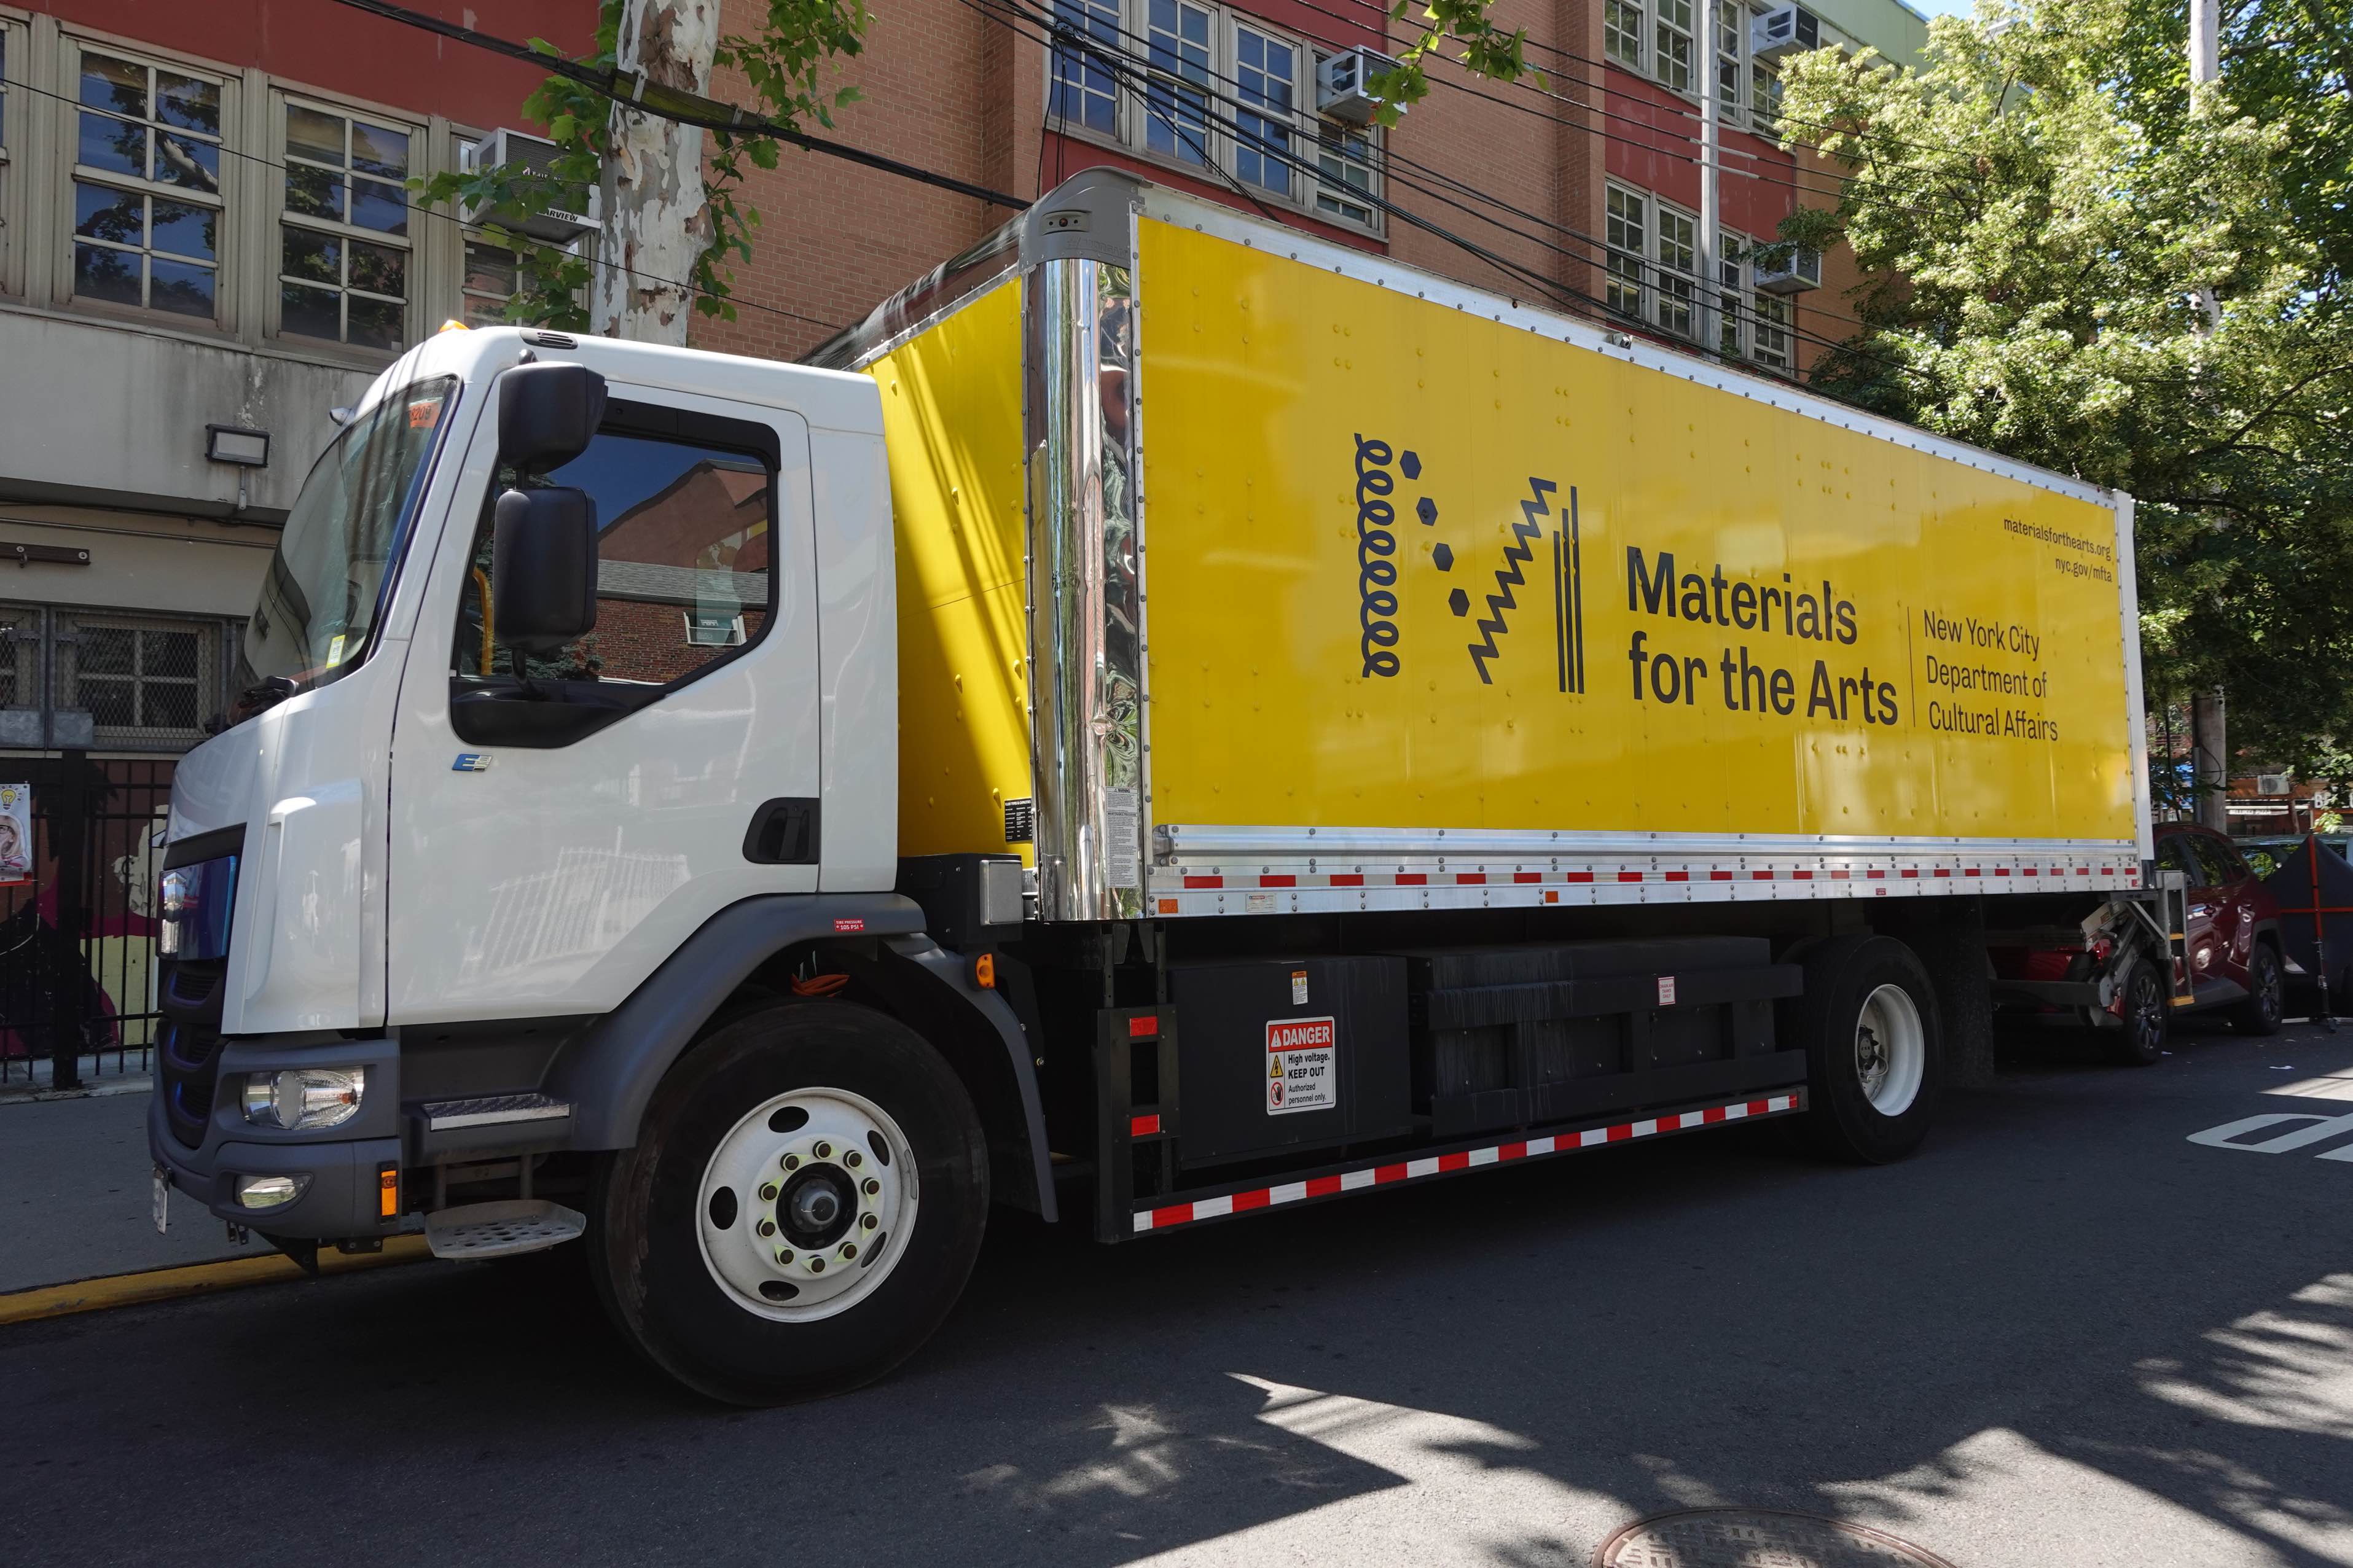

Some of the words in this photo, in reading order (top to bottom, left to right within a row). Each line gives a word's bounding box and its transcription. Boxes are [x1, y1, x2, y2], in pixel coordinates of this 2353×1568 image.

[2004, 518, 2111, 561] materialsforthearts.org
[2056, 558, 2112, 583] nyc.gov/mfta
[1627, 545, 1858, 645] Materials
[1924, 609, 1962, 643] New
[1966, 617, 2006, 650] York
[2010, 625, 2040, 661] City
[1628, 631, 1708, 706] for
[1720, 646, 1795, 716] the
[1807, 660, 1898, 725] Arts
[1927, 655, 2029, 696] Department
[2033, 671, 2047, 698] of
[1929, 701, 2000, 736] Cultural
[2004, 710, 2058, 741] Affairs
[1283, 1026, 1330, 1046] DANGER
[1288, 1053, 1303, 1066] High
[1304, 1052, 1330, 1065] voltage.
[1288, 1067, 1307, 1079] KEEP
[1310, 1066, 1325, 1077] OUT
[1288, 1082, 1316, 1093] Authorized
[1288, 1093, 1314, 1106] personnel
[1315, 1093, 1326, 1102] only.
